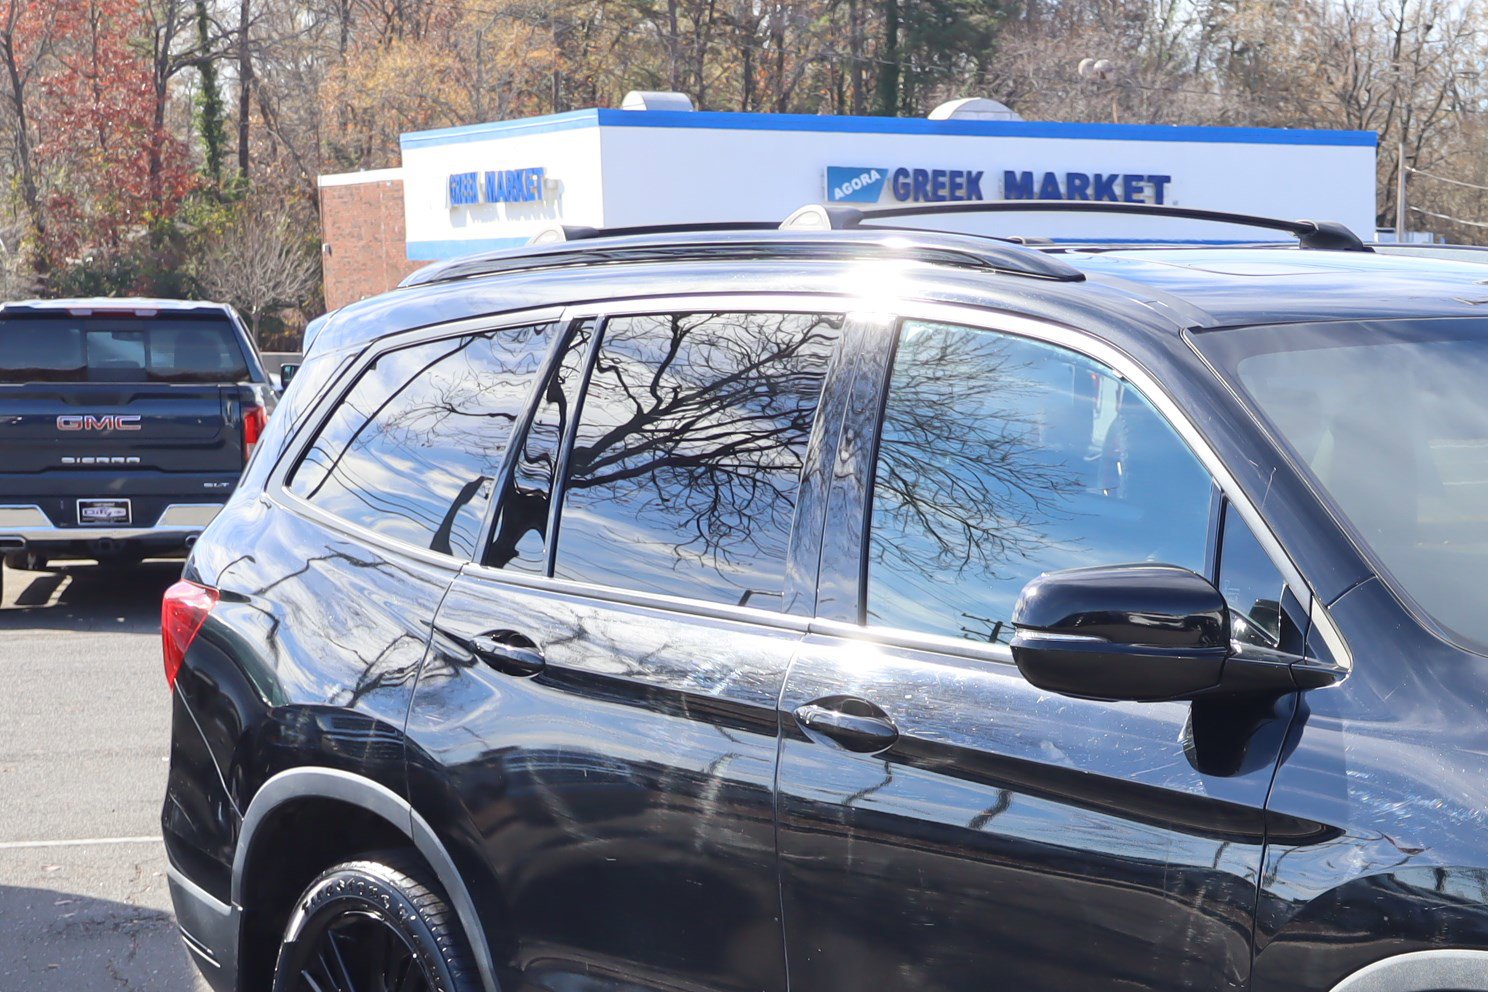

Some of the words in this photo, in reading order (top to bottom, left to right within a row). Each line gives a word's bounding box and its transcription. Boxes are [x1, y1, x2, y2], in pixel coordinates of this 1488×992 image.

[485, 166, 545, 203] MARKET
[833, 168, 882, 200] AGORA
[892, 167, 984, 202] GREEK
[1003, 170, 1171, 206] MARKET
[56, 415, 142, 431] GMC
